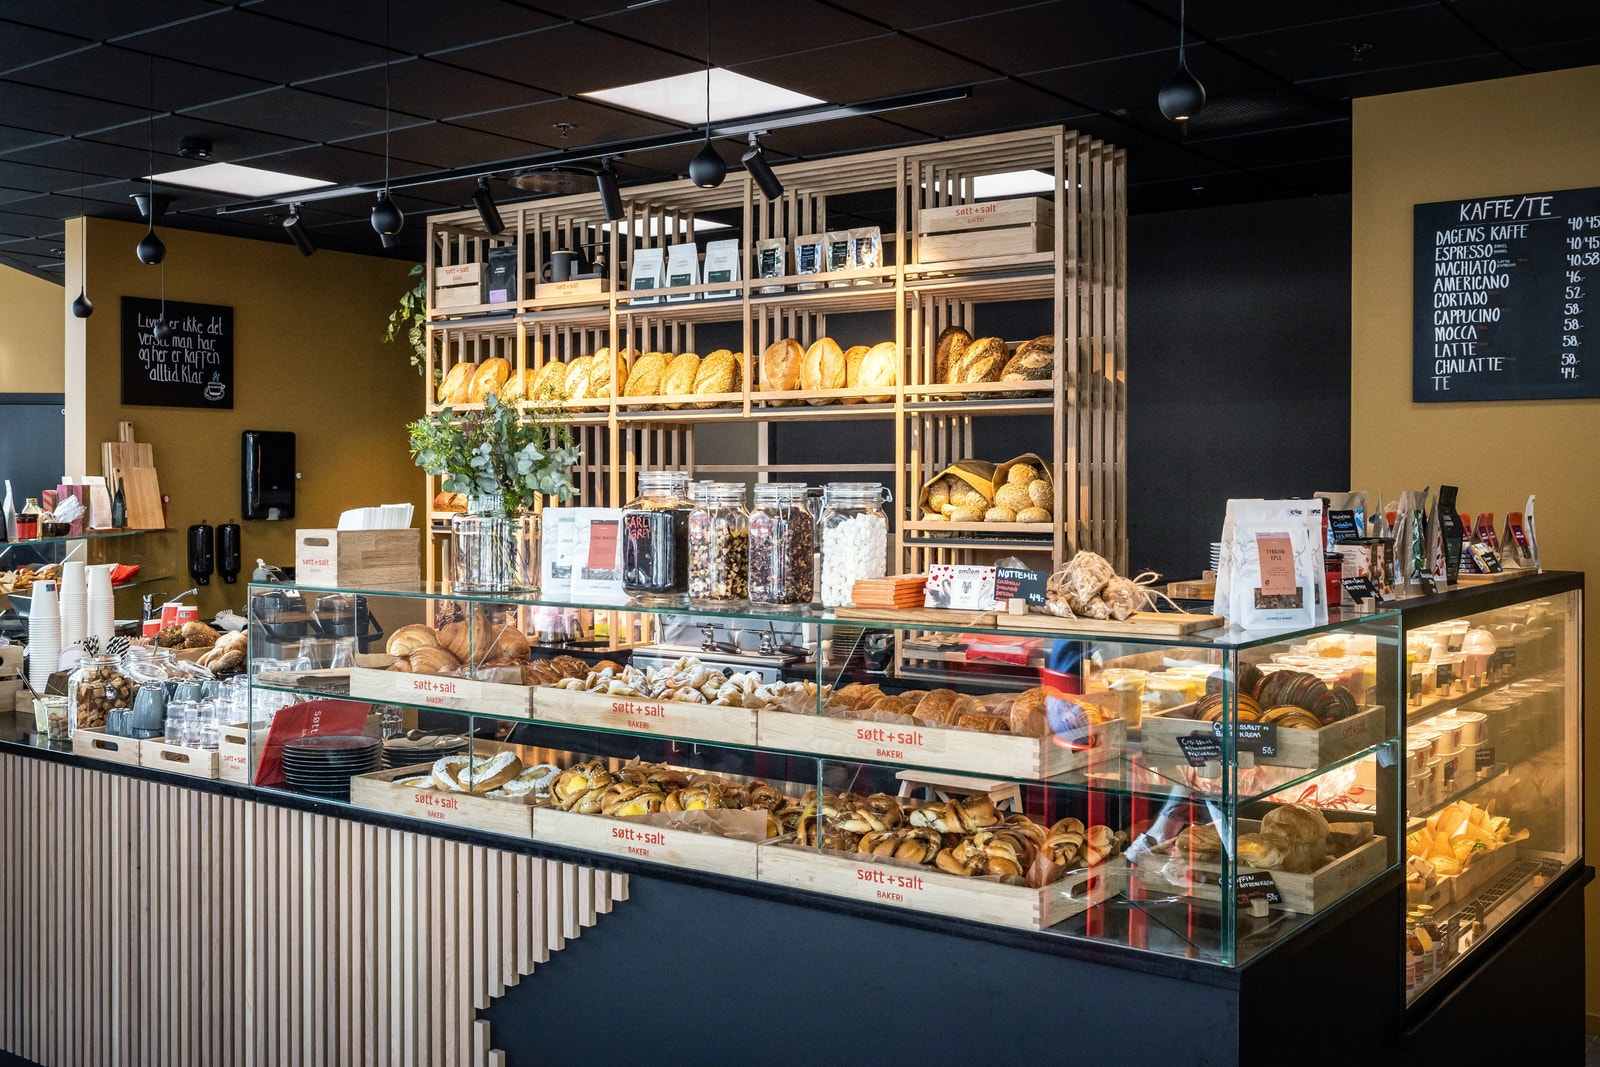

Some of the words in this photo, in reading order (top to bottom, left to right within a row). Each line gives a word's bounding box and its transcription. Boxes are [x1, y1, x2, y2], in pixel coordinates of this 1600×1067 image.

[955, 207, 973, 216] søtt
[980, 204, 996, 213] salt
[1460, 196, 1553, 221] KAFFE/TE
[1436, 226, 1486, 246] DAGENS
[1490, 224, 1530, 241] KAFFE
[1435, 244, 1493, 262] ESPRESSO
[1435, 259, 1497, 277] MACHIATO
[1434, 273, 1510, 292] AMERICANO
[1434, 291, 1488, 309] CORTADO
[1434, 307, 1501, 326] CAPPUCINO
[169, 320, 179, 330] er
[1435, 325, 1478, 342] MOCCA
[172, 335, 193, 349] man
[1435, 342, 1478, 358] LATTE
[152, 345, 168, 362] her
[171, 350, 181, 363] er
[1431, 376, 1451, 391] TE
[626, 516, 648, 529] EARL
[629, 528, 652, 540] GREY
[413, 680, 432, 691] søtt
[433, 683, 438, 691] +
[440, 681, 457, 694] salt
[426, 696, 444, 704] BAKERI
[612, 702, 634, 714] søtt
[636, 706, 643, 714] +
[645, 704, 665, 718] salt
[627, 720, 649, 729] BAKERI
[857, 728, 884, 742] søtt
[887, 732, 895, 742] +
[897, 731, 923, 746] salt
[876, 748, 903, 759] BAKERI
[415, 794, 433, 805] søtt
[441, 797, 458, 810] salt
[427, 811, 445, 819] BAKERI
[612, 828, 634, 840] søtt
[636, 832, 643, 841] +
[645, 831, 665, 846] salt
[627, 846, 649, 856] BAKERI
[857, 869, 884, 884] søtt
[887, 875, 895, 884] +
[897, 875, 923, 891] salt
[876, 890, 903, 901] BAKERI
